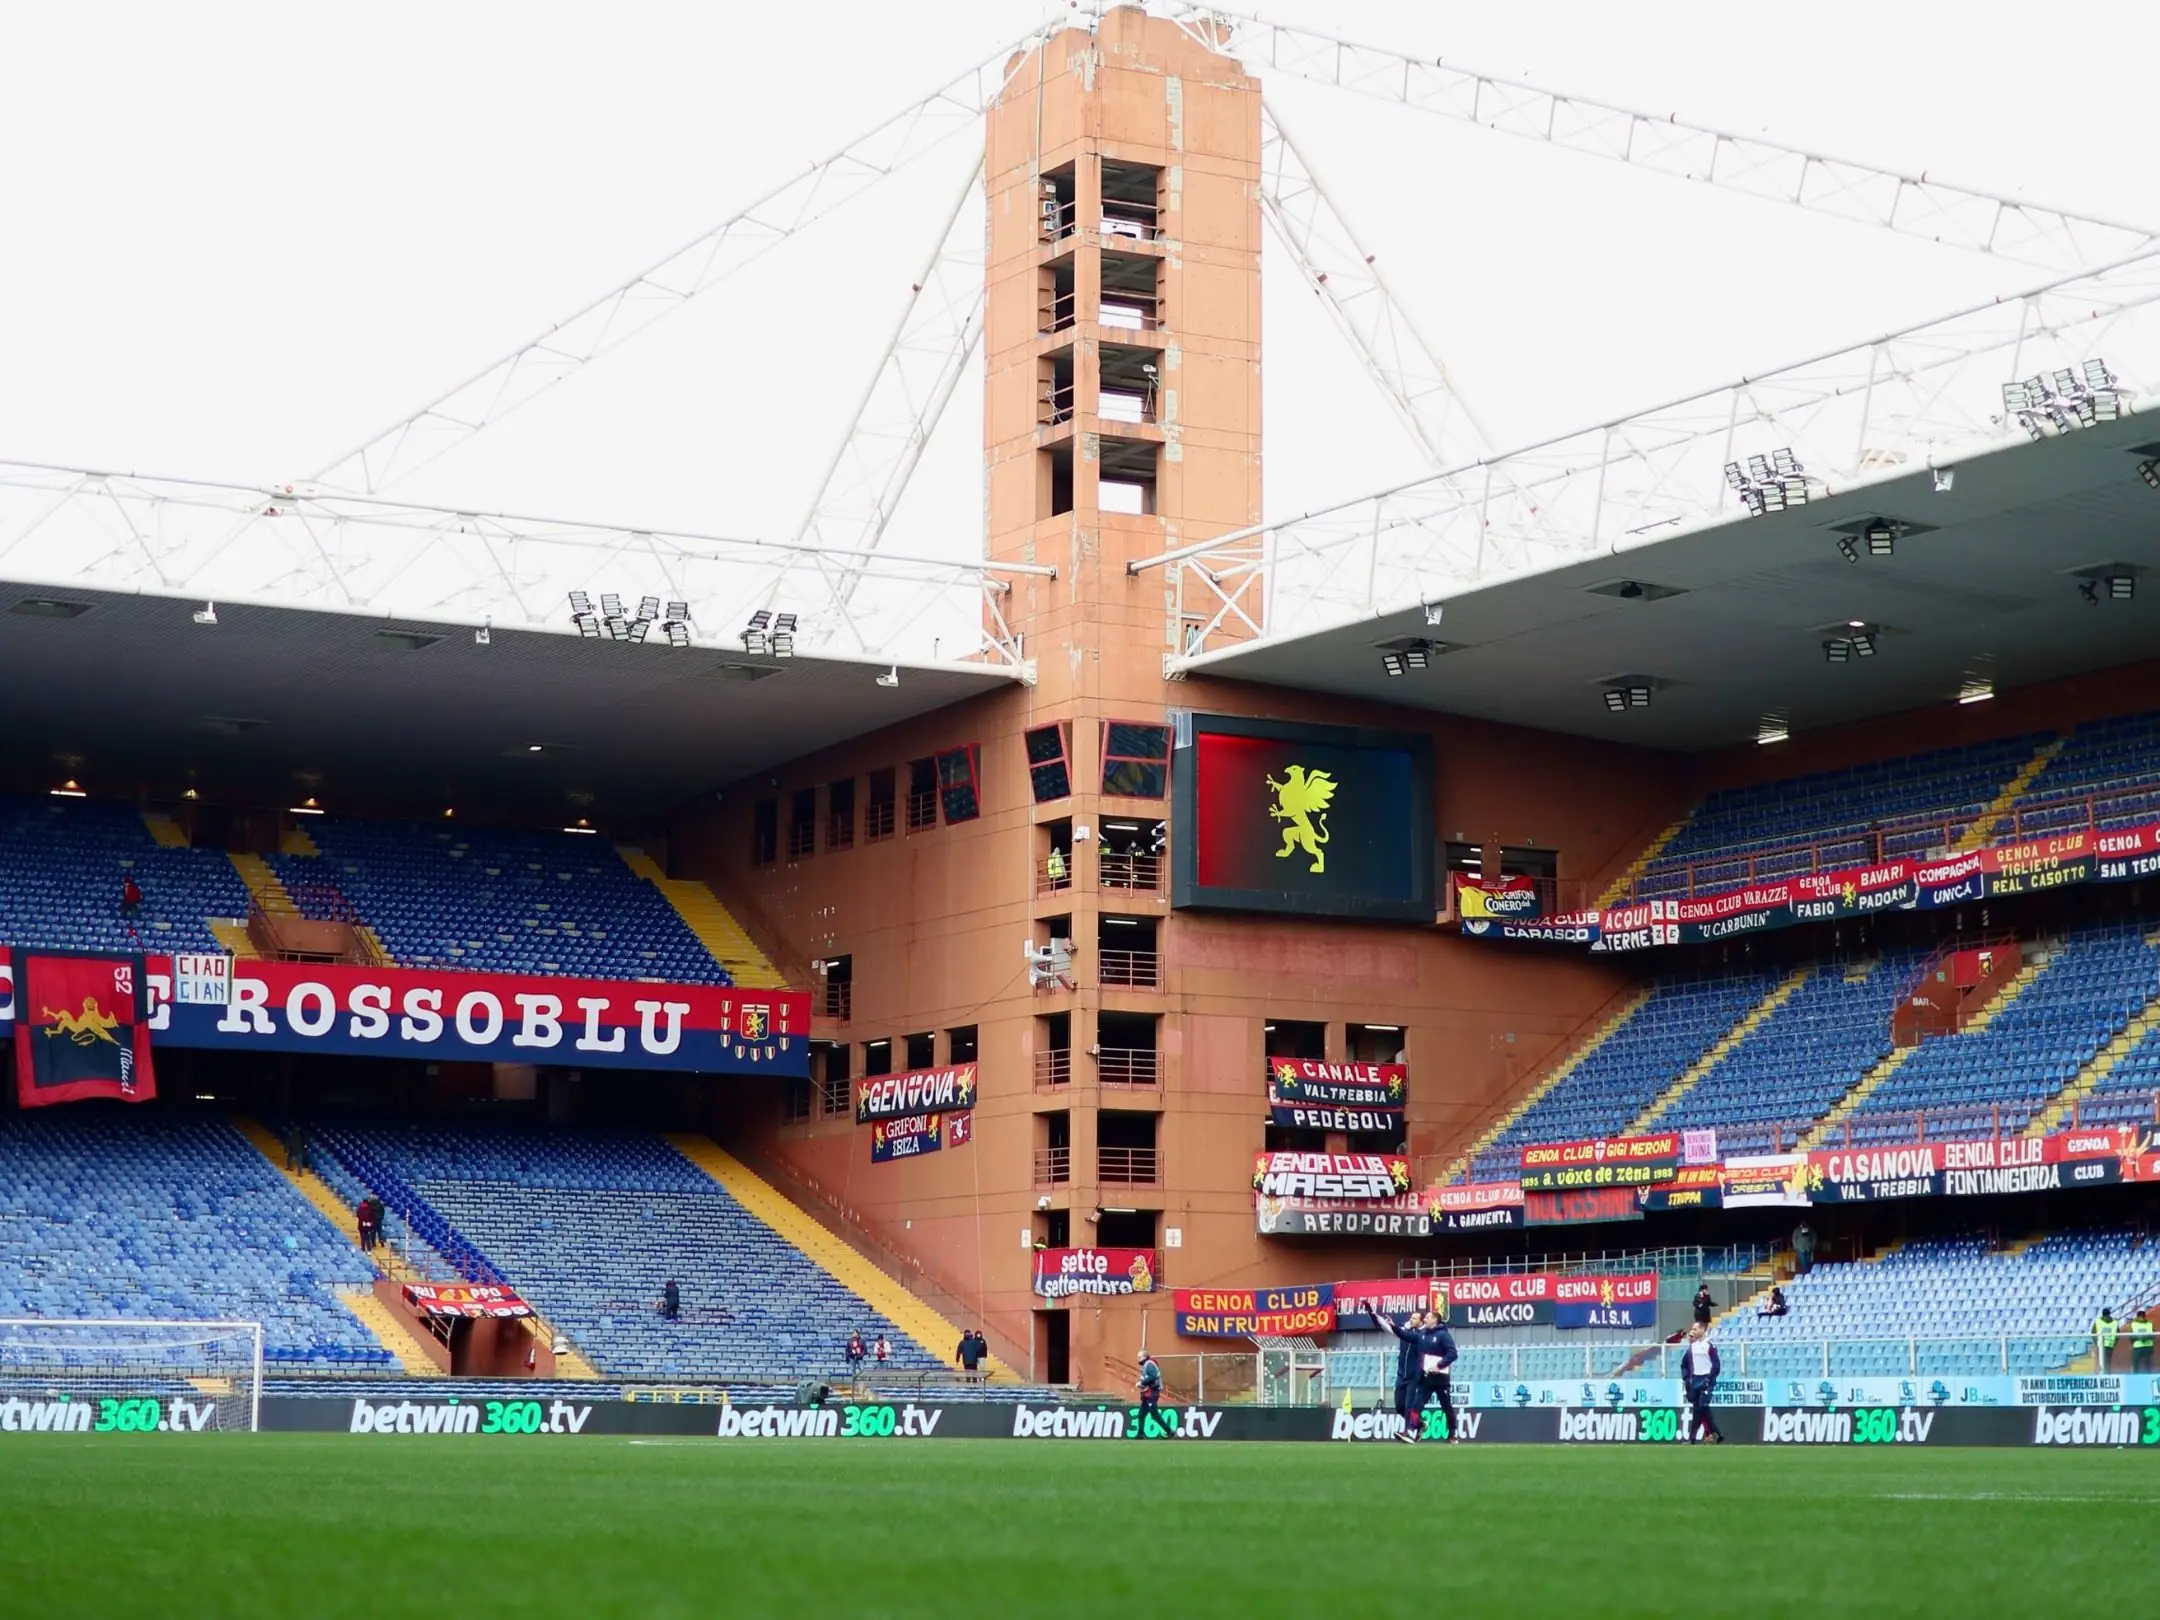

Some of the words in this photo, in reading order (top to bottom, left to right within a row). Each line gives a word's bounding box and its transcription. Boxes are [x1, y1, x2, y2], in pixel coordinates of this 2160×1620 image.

[1997, 845, 2039, 862] GENOA
[2050, 835, 2084, 854] CLUB
[2100, 834, 2142, 852] GENOA
[1861, 864, 1904, 886] BAVARI
[2001, 856, 2059, 877] TIGLIETO
[2101, 862, 2126, 878] SAN
[1799, 876, 1831, 889] GENOA
[1815, 883, 1842, 897] CLUB
[1993, 879, 2024, 894] REAL
[2031, 865, 2086, 889] CASOTTO
[1680, 904, 1714, 919] GENOA
[1716, 898, 1742, 915] CLUB
[1744, 886, 1789, 906] VARAZZE
[1859, 885, 1908, 910] PADOAN
[1933, 881, 1973, 904] UNICA
[1485, 897, 1522, 912] CONERO
[1797, 902, 1835, 918] FABIO
[1555, 911, 1600, 925] CLUB
[1605, 907, 1648, 931] ACQUI
[1504, 927, 1589, 941] CARASCO
[1605, 929, 1651, 951] TERME
[179, 957, 225, 977] CIAO
[113, 966, 133, 995] 52
[180, 981, 225, 1002] CIAN
[1912, 997, 1930, 1007] BAR
[216, 978, 691, 1054] ROSSOBLU
[1303, 1062, 1381, 1083] CANALE
[886, 1114, 928, 1138] GRIFONI
[1293, 1109, 1393, 1130] PEDEGOLI
[892, 1136, 920, 1157] IBIZA
[1525, 1151, 1560, 1164] GENOA
[1563, 1145, 1594, 1161] CLUB
[1606, 1142, 1627, 1157] GIGI
[1629, 1138, 1672, 1156] MERONI
[1945, 1142, 1995, 1169] GENOA
[2000, 1138, 2043, 1165] CLUB
[2067, 1136, 2111, 1153] GENOA
[1269, 1153, 1333, 1173] GENOA
[1334, 1155, 1389, 1175] CLUB
[1828, 1148, 1936, 1183] CASANOVA
[2074, 1164, 2105, 1180] CLUB
[1262, 1172, 1397, 1198] MASSA
[1595, 1166, 1613, 1184] de
[1945, 1164, 2061, 1196] FONTANIGORDA
[1440, 1190, 1472, 1206] GENOA
[1475, 1188, 1499, 1203] CLUB
[1840, 1184, 1866, 1200] VAL
[1871, 1178, 1931, 1198] TREBBIA
[1303, 1213, 1429, 1234] AEROPORTO
[1061, 1248, 1108, 1274] sette
[1044, 1274, 1133, 1298] settembre
[1454, 1281, 1500, 1300] GENOA
[1510, 1278, 1546, 1297] CLUB
[1557, 1281, 1598, 1298] GENOA
[1616, 1280, 1651, 1297] CLUB
[1190, 1293, 1254, 1312] GENOA
[1267, 1290, 1319, 1310] CLUB
[1334, 1297, 1354, 1316] ENOA
[1185, 1315, 1219, 1333] SAN
[1223, 1311, 1329, 1334] FRUTTUOSO
[1467, 1304, 1534, 1324] LAGACCIO
